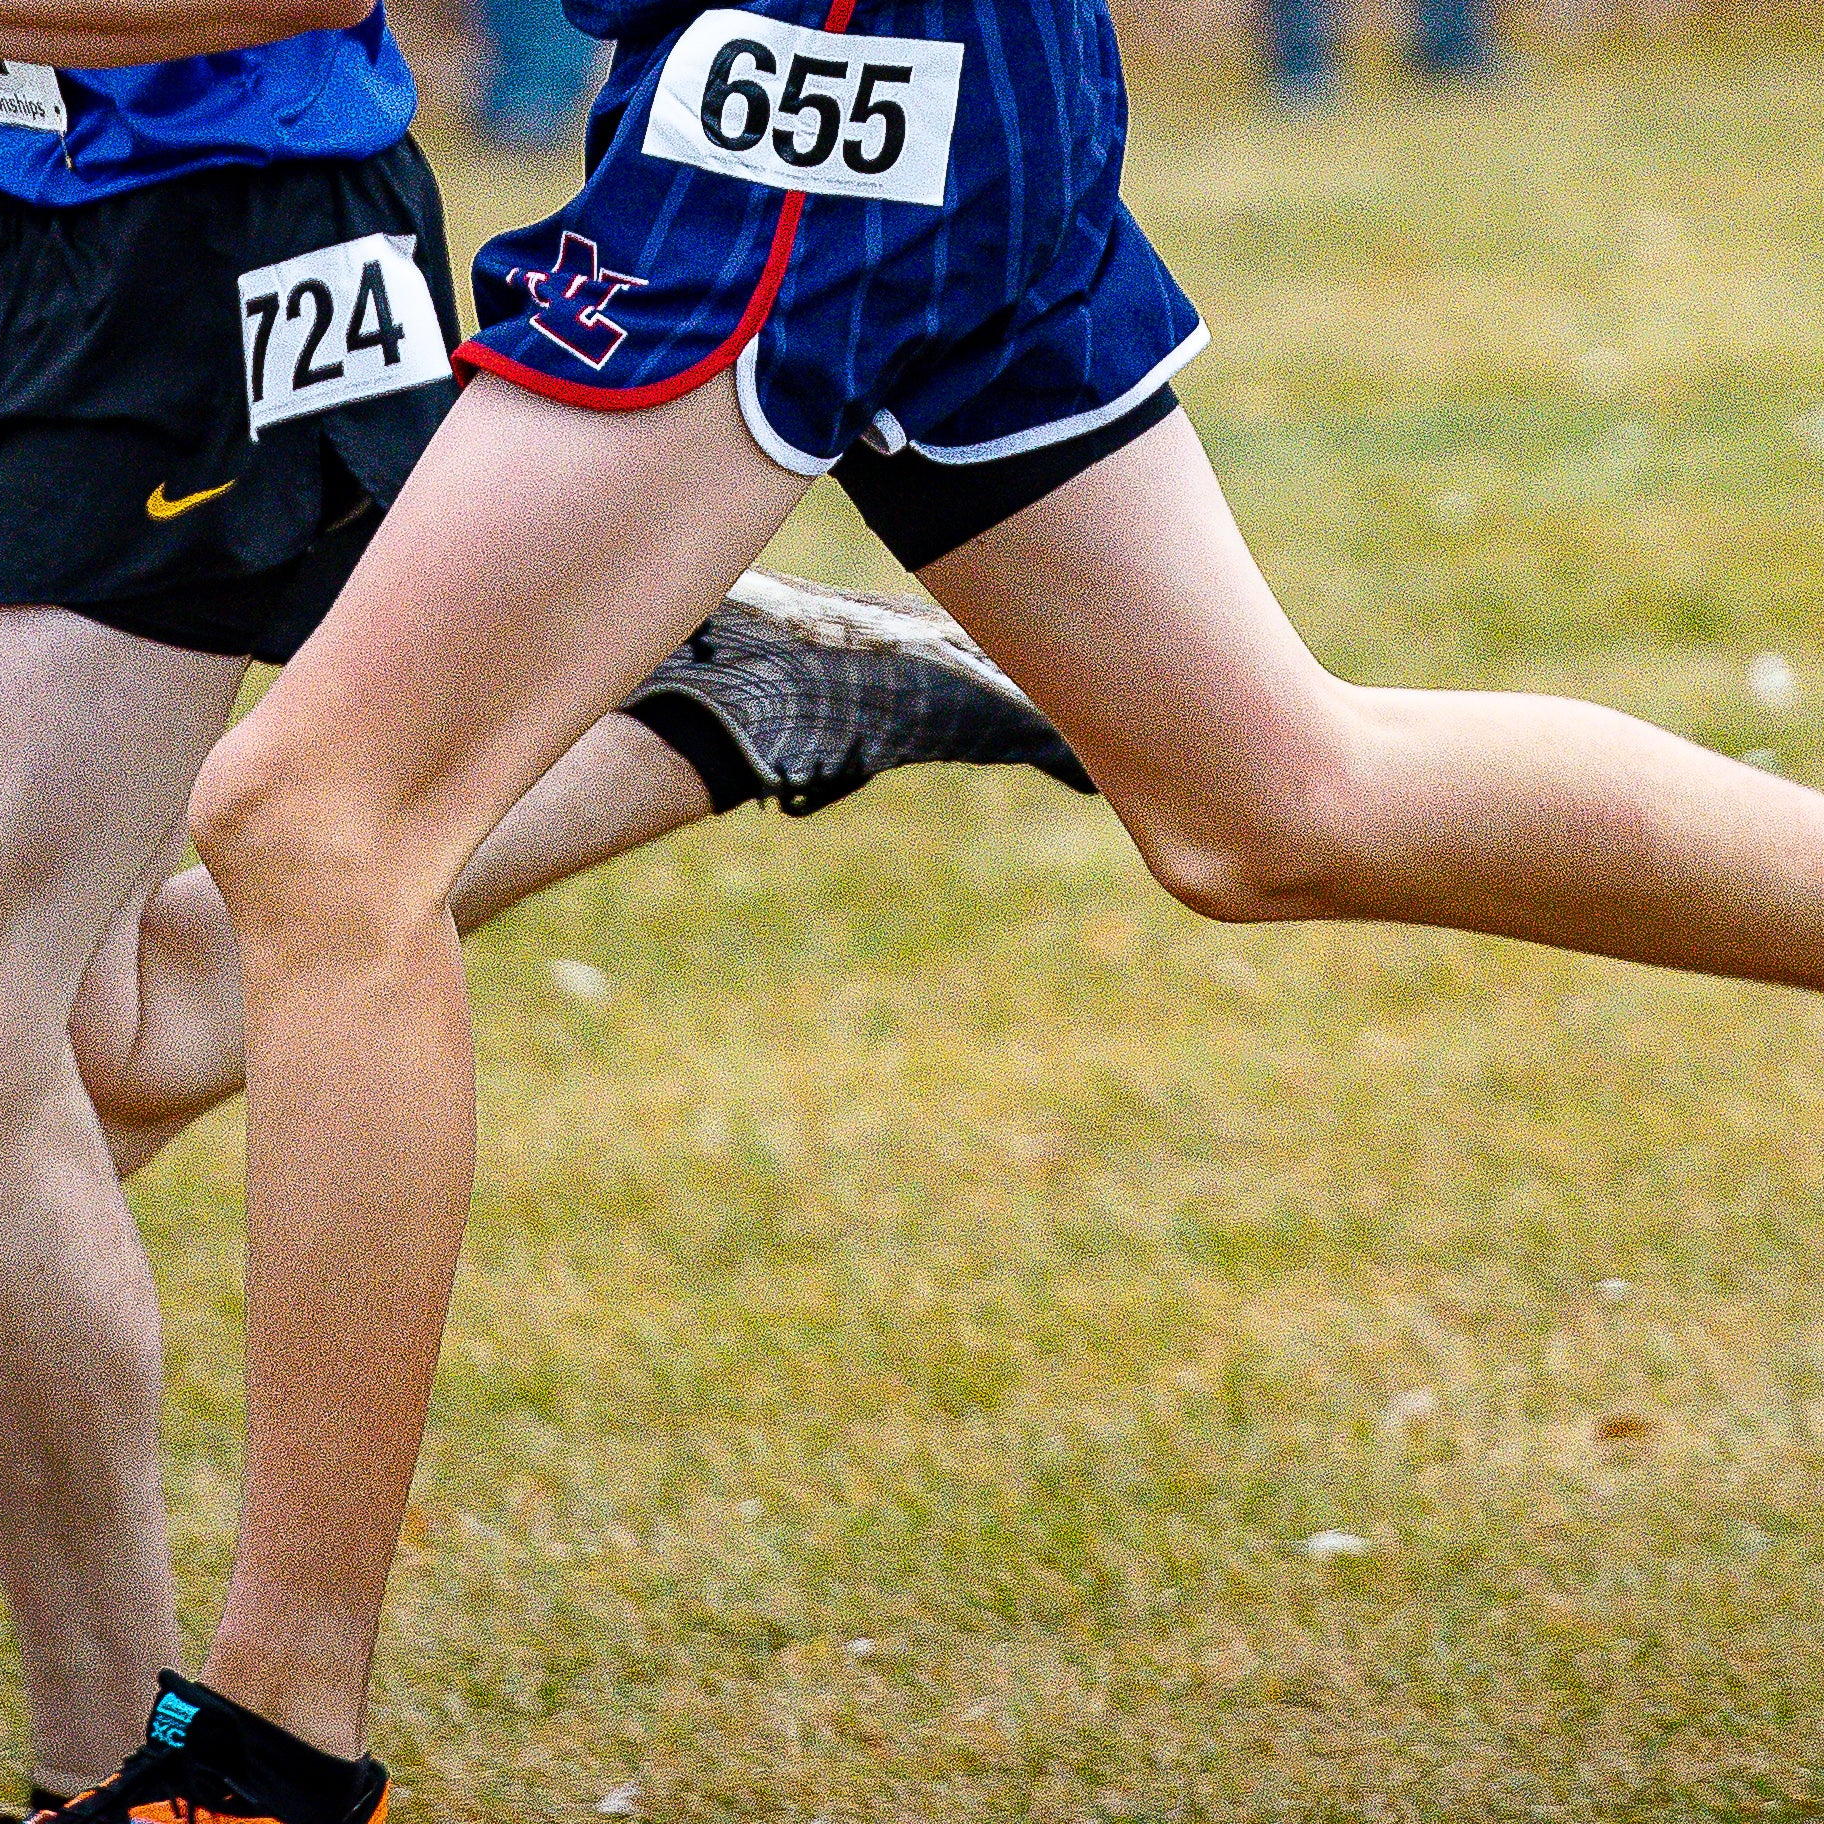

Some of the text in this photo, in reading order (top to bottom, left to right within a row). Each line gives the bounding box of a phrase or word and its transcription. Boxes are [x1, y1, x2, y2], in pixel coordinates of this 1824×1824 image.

[701, 37, 914, 175] 655
[246, 259, 406, 403] 724
[151, 1721, 186, 1747] XC
